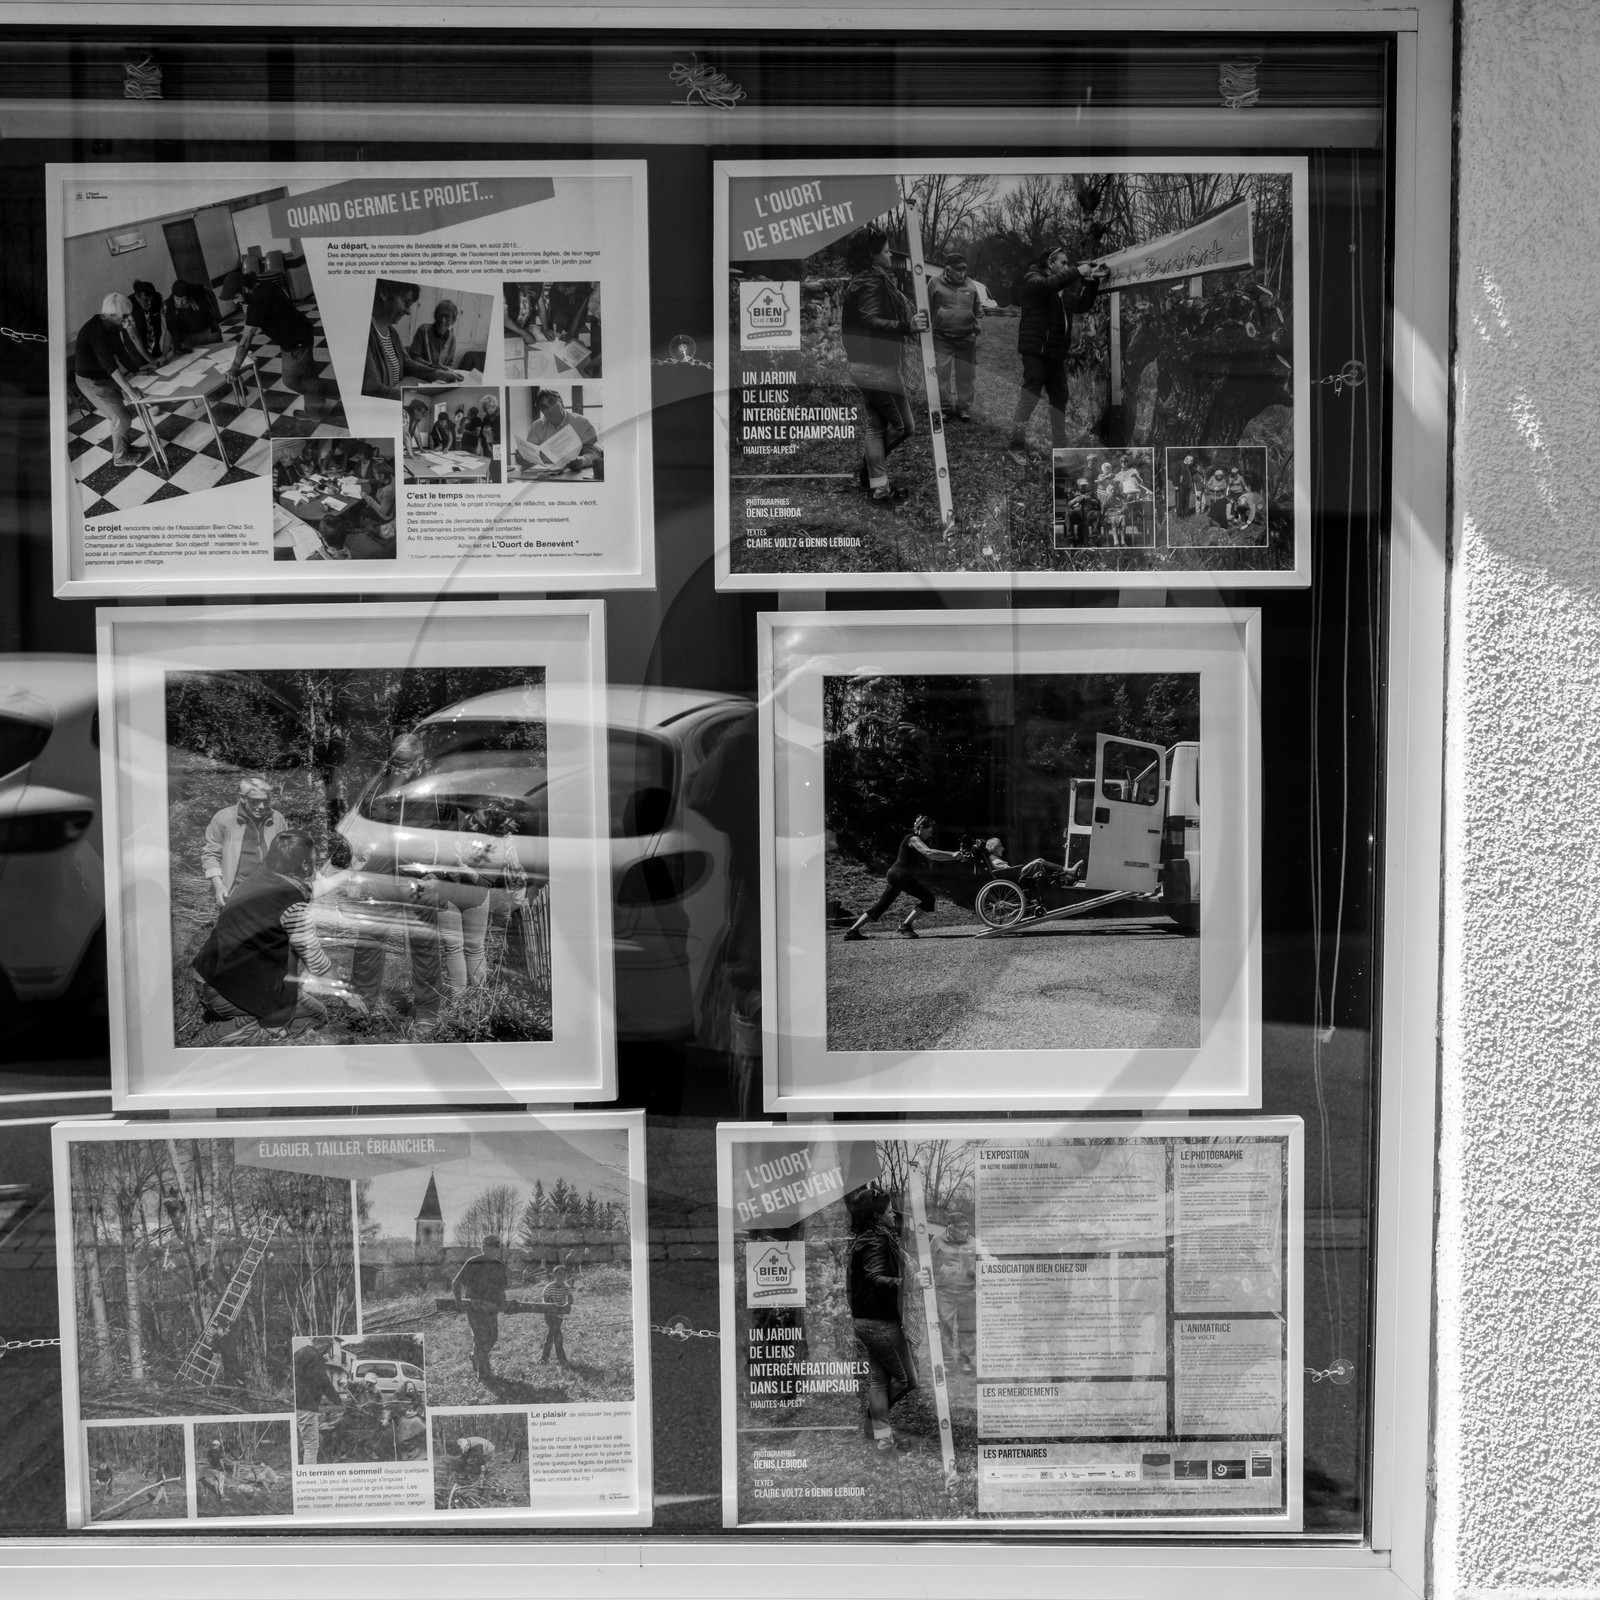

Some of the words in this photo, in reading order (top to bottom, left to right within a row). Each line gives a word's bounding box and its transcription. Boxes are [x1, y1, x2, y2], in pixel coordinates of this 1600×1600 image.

[755, 180, 823, 218] L'OUORT
[287, 202, 341, 228] QUAND
[344, 194, 399, 220] GERME
[401, 190, 421, 211] LE
[424, 182, 494, 208] PROJET...
[743, 227, 768, 252] DE
[769, 201, 855, 245] BENEVÈNT
[341, 243, 369, 251] départ,
[753, 308, 782, 317] BIEN
[743, 372, 758, 385] UN
[760, 371, 796, 385] JARDIN
[744, 390, 756, 403] DE
[760, 390, 789, 403] LIENS
[744, 405, 858, 421] INTERGÉNÉRATIONELS
[744, 426, 773, 439] DANS
[775, 426, 787, 439] LE
[790, 426, 855, 439] CHAMPSAUR
[439, 493, 463, 501] temps
[747, 508, 768, 518] DENIS
[770, 508, 801, 518] LEBIODA
[98, 525, 122, 533] projet
[492, 541, 522, 549] L'Ouort
[747, 539, 773, 548] CLAIRE
[775, 538, 797, 548] VOLTZ
[799, 538, 804, 548] &
[806, 538, 827, 547] DENIS
[830, 538, 861, 547] LEBIODA
[259, 1141, 313, 1158] ÉLAGUER,
[315, 1141, 364, 1157] TAILLER,
[980, 1150, 1030, 1160] L'EXPOSITION
[1181, 1151, 1189, 1161] LE
[1191, 1150, 1244, 1160] PHOTOGRAPHE
[745, 1148, 812, 1189] L'OUORT
[737, 1198, 762, 1223] DE
[761, 1167, 845, 1213] BENEVÈNT
[760, 1267, 788, 1276] BIEN
[982, 1265, 1035, 1274] L'ASSOCIATION
[1037, 1264, 1053, 1273] BIEN
[1055, 1264, 1074, 1273] CHEZ
[1076, 1264, 1087, 1273] SOI
[1181, 1324, 1232, 1333] L'ANIMATRICE
[750, 1329, 764, 1342] UN
[766, 1328, 802, 1341] JARDIN
[750, 1346, 763, 1359] DE
[766, 1346, 795, 1358] LIENS
[750, 1361, 869, 1377] INTERGÉNÉRATIONNELS
[751, 1382, 778, 1394] DANS
[781, 1381, 793, 1394] LE
[796, 1380, 860, 1393] CHAMPSAUR
[983, 1388, 996, 1398] LES
[998, 1388, 1059, 1397] REMERCIEMENTS
[543, 1411, 567, 1420] plaisir
[754, 1450, 796, 1458] PHOTOGRAPHIES
[984, 1450, 997, 1459] LES
[999, 1449, 1047, 1459] PARTENAIRES
[754, 1460, 776, 1469] DENIS
[777, 1459, 808, 1469] LEBIODA
[349, 1468, 382, 1476] sommeil
[755, 1489, 780, 1498] CLAIRE
[782, 1488, 803, 1498] VOLTZ
[806, 1488, 810, 1497] &
[812, 1488, 833, 1497] DENIS
[835, 1487, 865, 1497] LEBIODA
